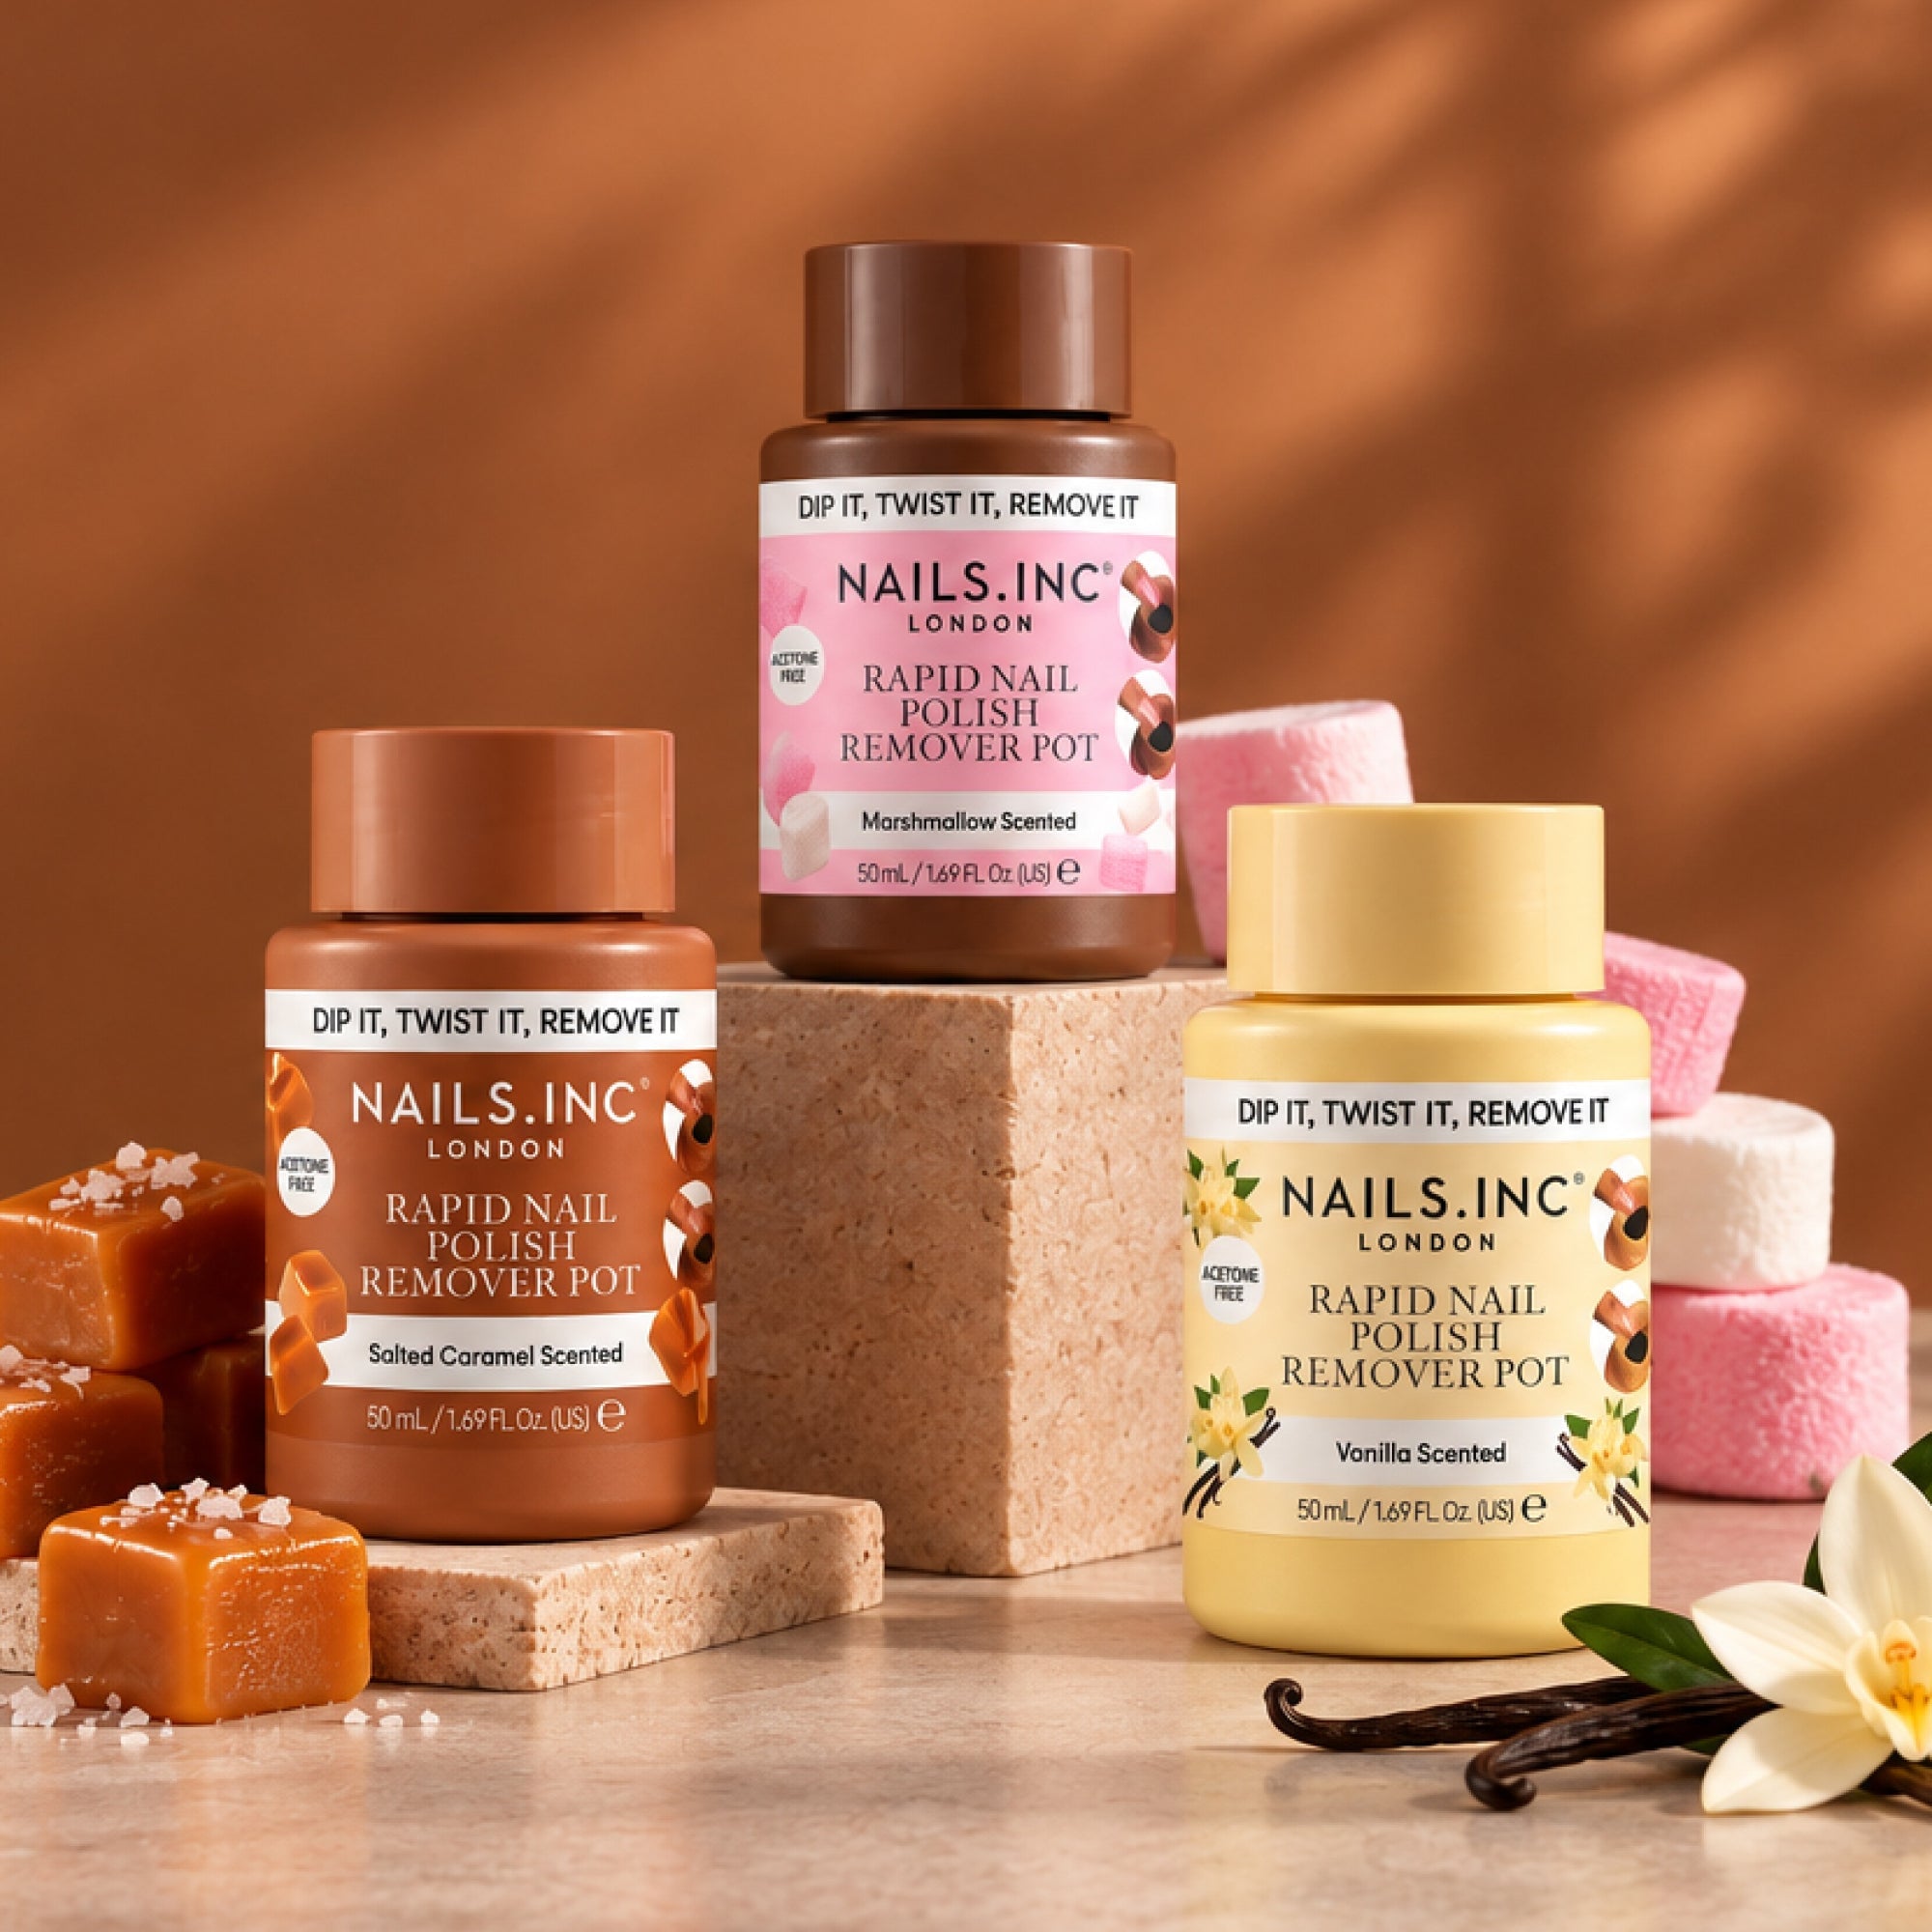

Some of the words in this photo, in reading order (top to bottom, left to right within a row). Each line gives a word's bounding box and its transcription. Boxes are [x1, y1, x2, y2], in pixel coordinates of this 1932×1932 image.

[799, 494, 835, 519] DIP
[842, 494, 868, 520] IT,
[876, 493, 961, 517] TWIST
[970, 493, 1002, 520] IT,
[1009, 494, 1114, 518] REMOVE
[1121, 495, 1139, 519] IT
[908, 614, 1033, 634] LONDON
[863, 665, 980, 693] RAPID
[991, 665, 1079, 693] NAIL
[900, 698, 1038, 727] POLISH
[840, 733, 1023, 762] REMOVER
[1033, 733, 1099, 762] POT
[862, 812, 997, 831] Marshmallow
[1000, 812, 1076, 831] Scented
[313, 1008, 351, 1035] DIP
[359, 1008, 387, 1038] IT,
[396, 1008, 488, 1035] TWIST
[498, 1008, 531, 1038] IT,
[541, 1008, 653, 1035] REMOVE
[660, 1007, 680, 1033] IT
[1238, 1098, 1279, 1125] DIP
[1287, 1098, 1315, 1130] IT,
[1322, 1100, 1415, 1125] TWIST
[1426, 1100, 1459, 1130] IT,
[1468, 1098, 1582, 1127] REMOVE
[1589, 1097, 1609, 1122] IT
[428, 1138, 564, 1159] LONDON
[385, 1193, 512, 1224] RAPID
[524, 1193, 617, 1224] NAIL
[428, 1231, 576, 1262] POLISH
[1359, 1232, 1496, 1252] LONDON
[359, 1265, 557, 1298] REMOVER
[569, 1264, 640, 1296] POT
[1310, 1284, 1435, 1316] RAPID
[1449, 1284, 1546, 1316] NAIL
[1351, 1322, 1500, 1352] POLISH
[369, 1343, 434, 1367] Salted
[440, 1343, 535, 1367] Caramel
[541, 1342, 624, 1366] Scented
[1281, 1356, 1483, 1388] REMOVER
[1495, 1356, 1570, 1386] POT
[1336, 1442, 1412, 1463] Vanilla
[1417, 1442, 1507, 1463] Scented
